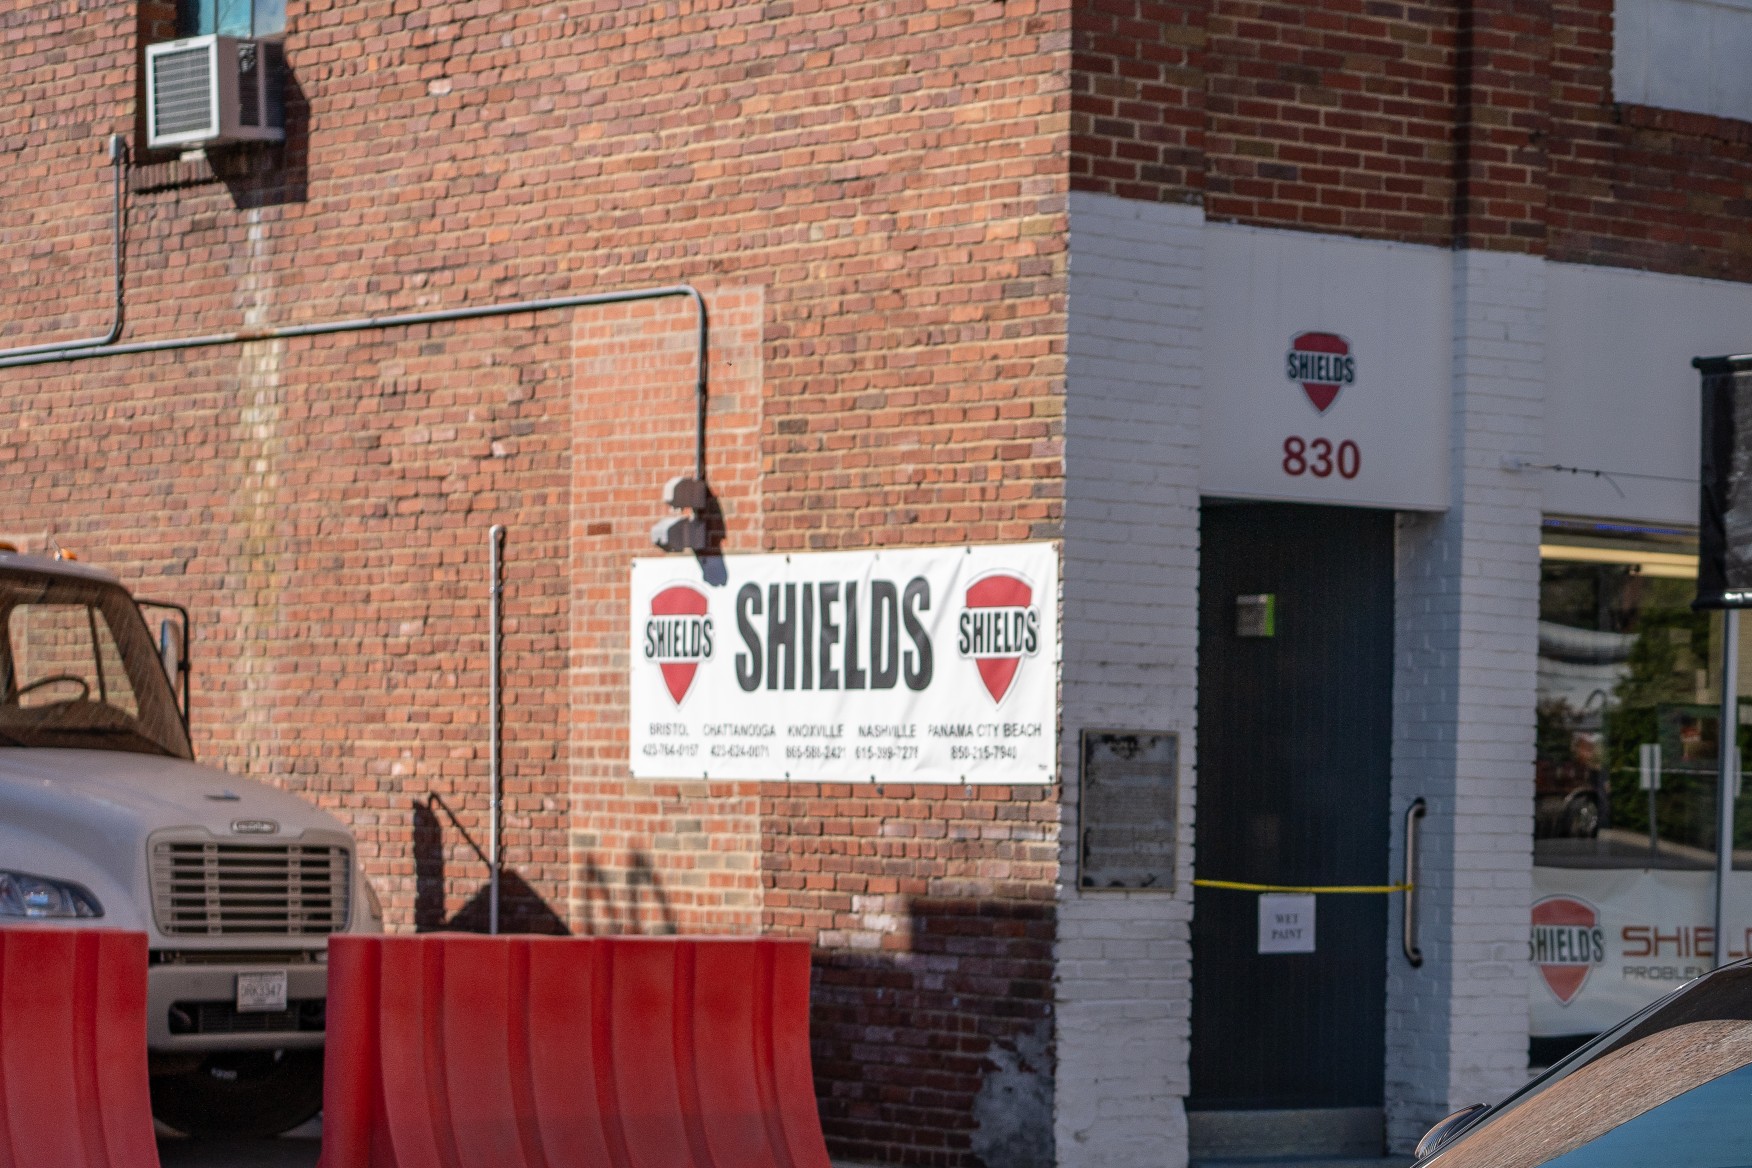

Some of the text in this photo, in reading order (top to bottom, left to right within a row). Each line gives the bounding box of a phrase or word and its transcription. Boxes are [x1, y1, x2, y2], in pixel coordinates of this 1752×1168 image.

[1288, 353, 1355, 383] SHIELDS
[1282, 436, 1361, 480] 830
[645, 619, 714, 660] SHIELDS
[734, 575, 934, 693] SHIELDS
[958, 610, 1040, 656] SHIELDS
[703, 723, 776, 738] CHATTANOOGA
[787, 723, 845, 739] KNOXVILLE
[858, 723, 917, 739] NASHVILLE
[928, 723, 974, 738] PANAMA
[1003, 722, 1042, 738] BEACH
